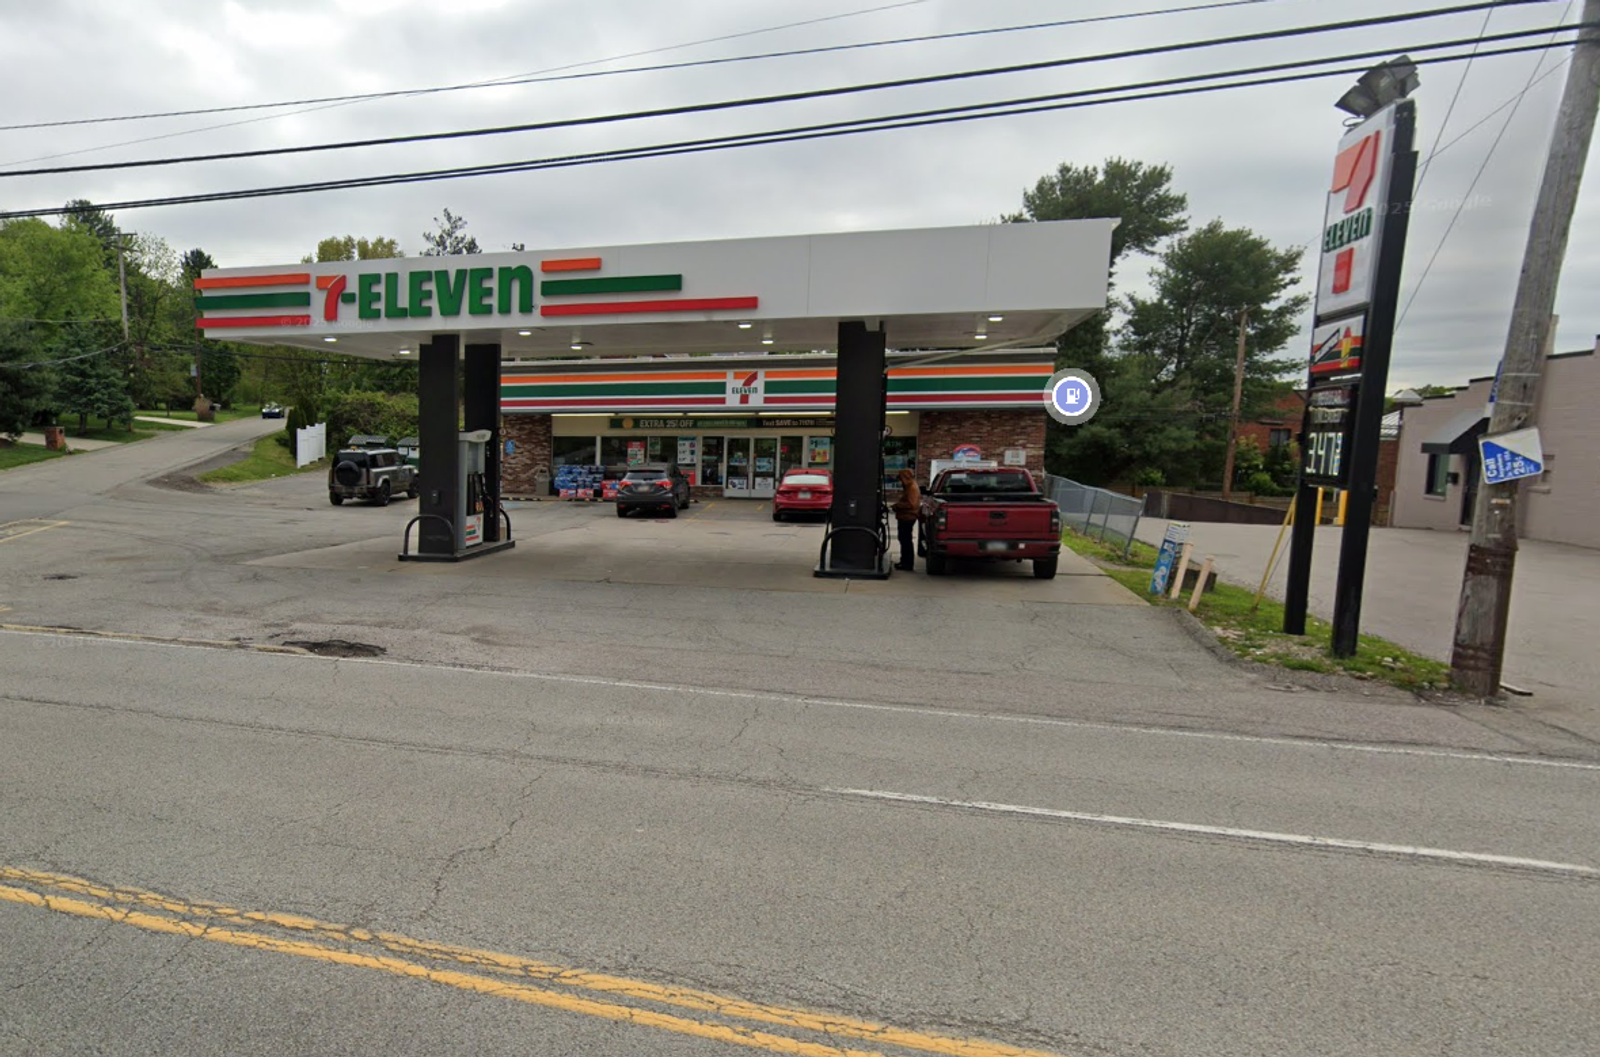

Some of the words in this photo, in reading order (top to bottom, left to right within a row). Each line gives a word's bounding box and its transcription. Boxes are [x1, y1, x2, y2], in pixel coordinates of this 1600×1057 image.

[734, 371, 758, 404] 7
[679, 419, 694, 428] OFF
[1485, 457, 1498, 478] Call
